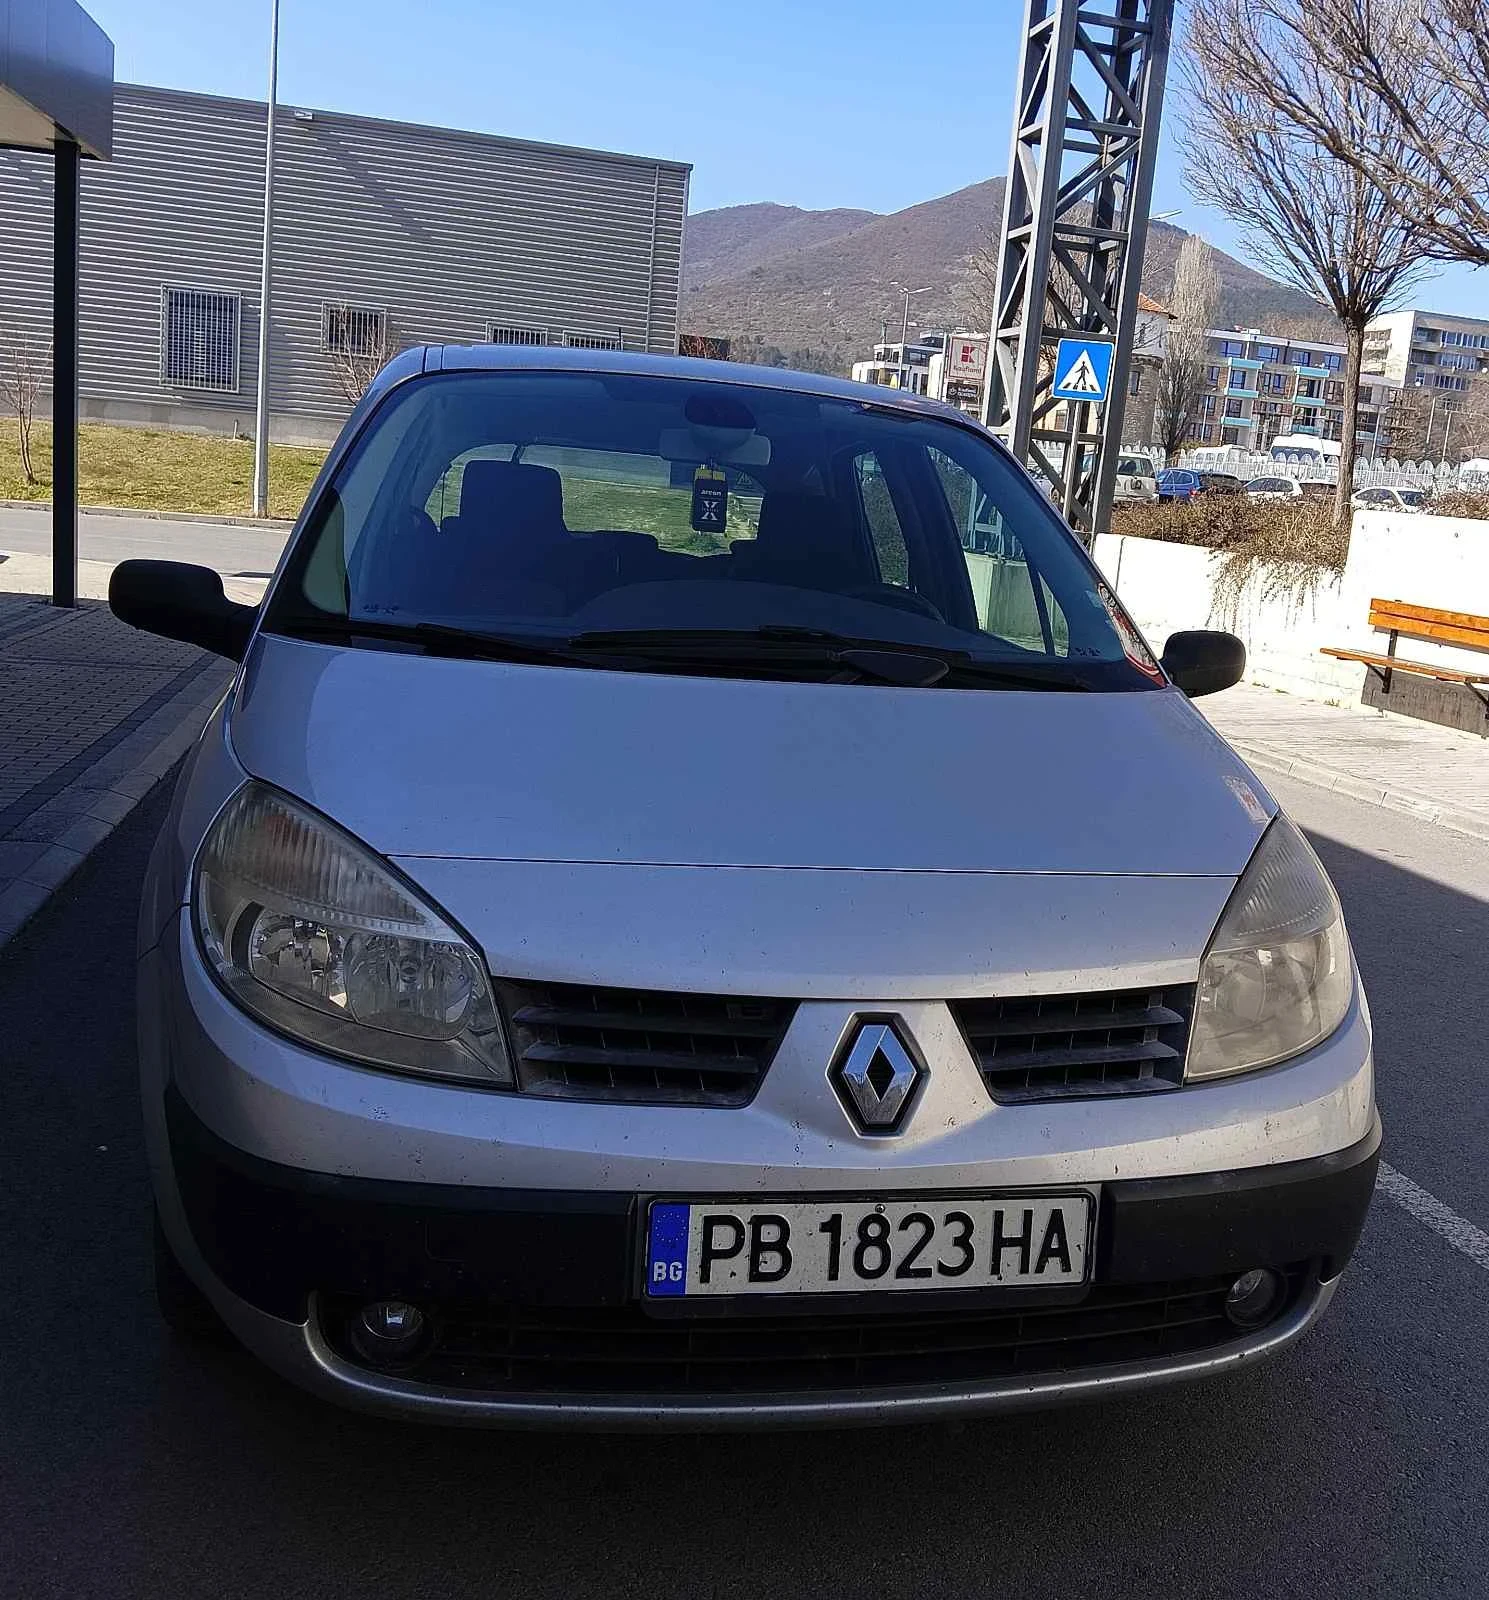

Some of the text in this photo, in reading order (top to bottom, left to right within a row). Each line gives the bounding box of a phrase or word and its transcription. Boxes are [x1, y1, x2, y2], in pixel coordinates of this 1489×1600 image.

[699, 1208, 1073, 1284] PB 1823 HA
[652, 1261, 683, 1283] BG
